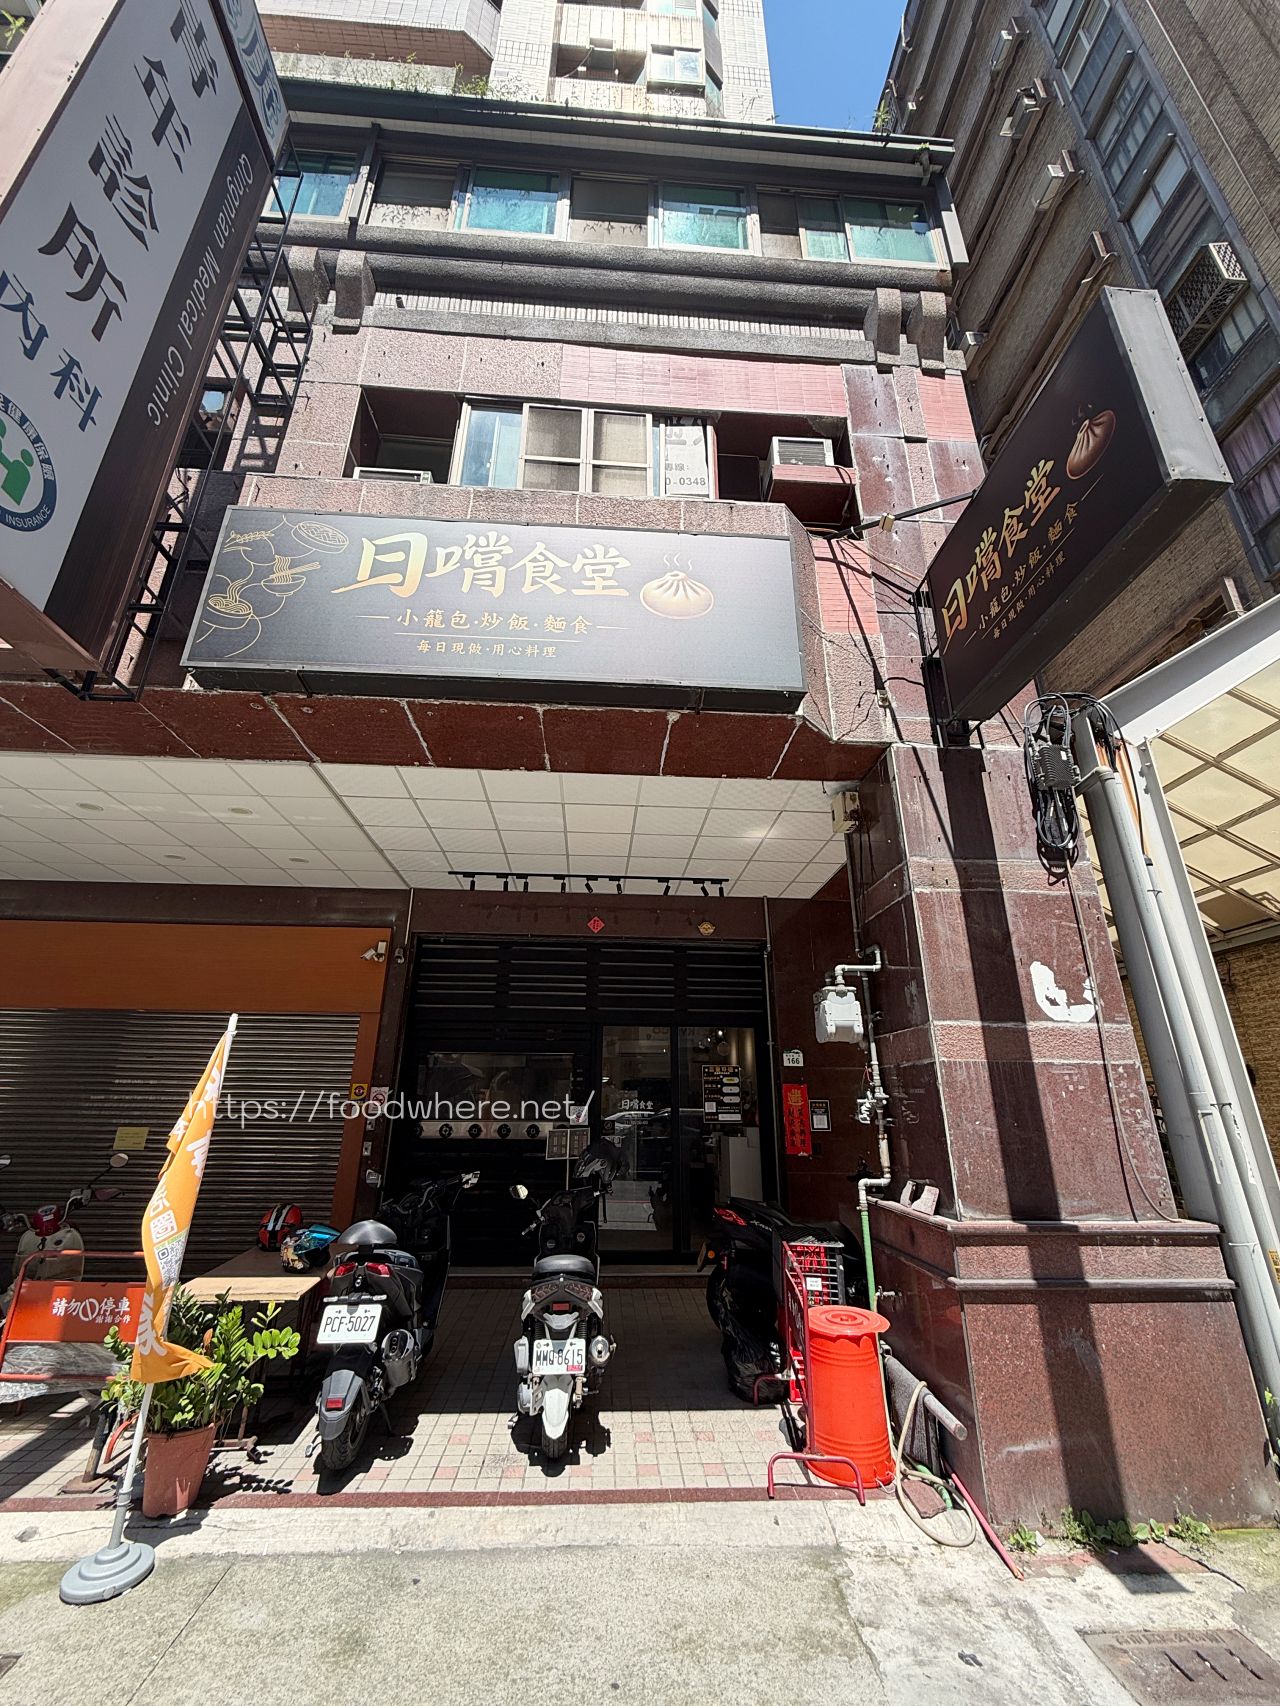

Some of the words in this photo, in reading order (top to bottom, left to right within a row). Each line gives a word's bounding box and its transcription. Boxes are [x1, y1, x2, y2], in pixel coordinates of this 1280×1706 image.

[213, 153, 254, 249] Qingnian
[177, 246, 221, 350] Medical
[147, 345, 186, 427] Clinic
[5, 504, 51, 528] INSURANCE
[331, 530, 632, 598] 日嚐食堂
[787, 1057, 800, 1065] 166
[52, 1296, 81, 1317] 請勿
[100, 1296, 131, 1316] 停車
